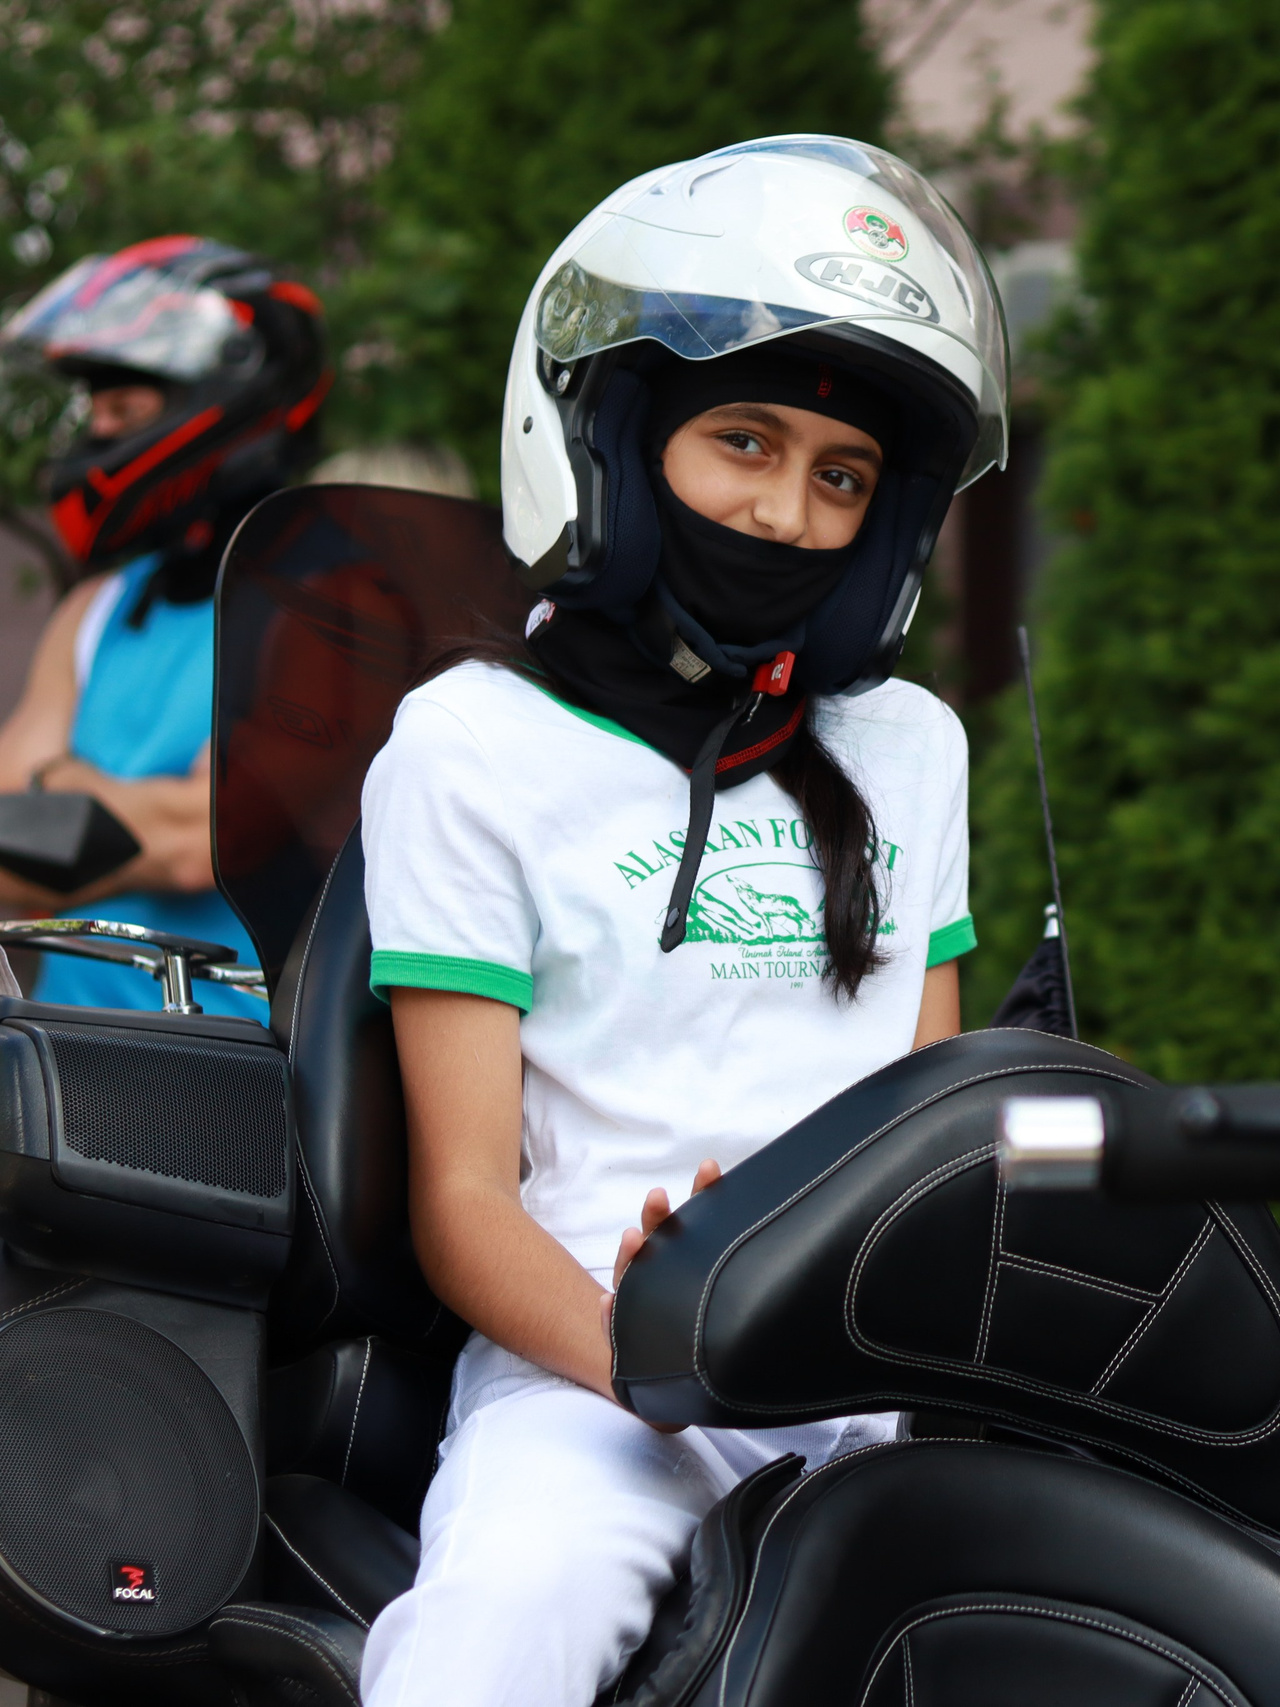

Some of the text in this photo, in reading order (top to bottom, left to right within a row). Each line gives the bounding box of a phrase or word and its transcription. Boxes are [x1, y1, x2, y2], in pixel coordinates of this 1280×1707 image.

[820, 259, 925, 314] HJC
[766, 818, 904, 872] FOST
[711, 962, 760, 979] MAIN
[115, 1587, 155, 1600] FOCAL
